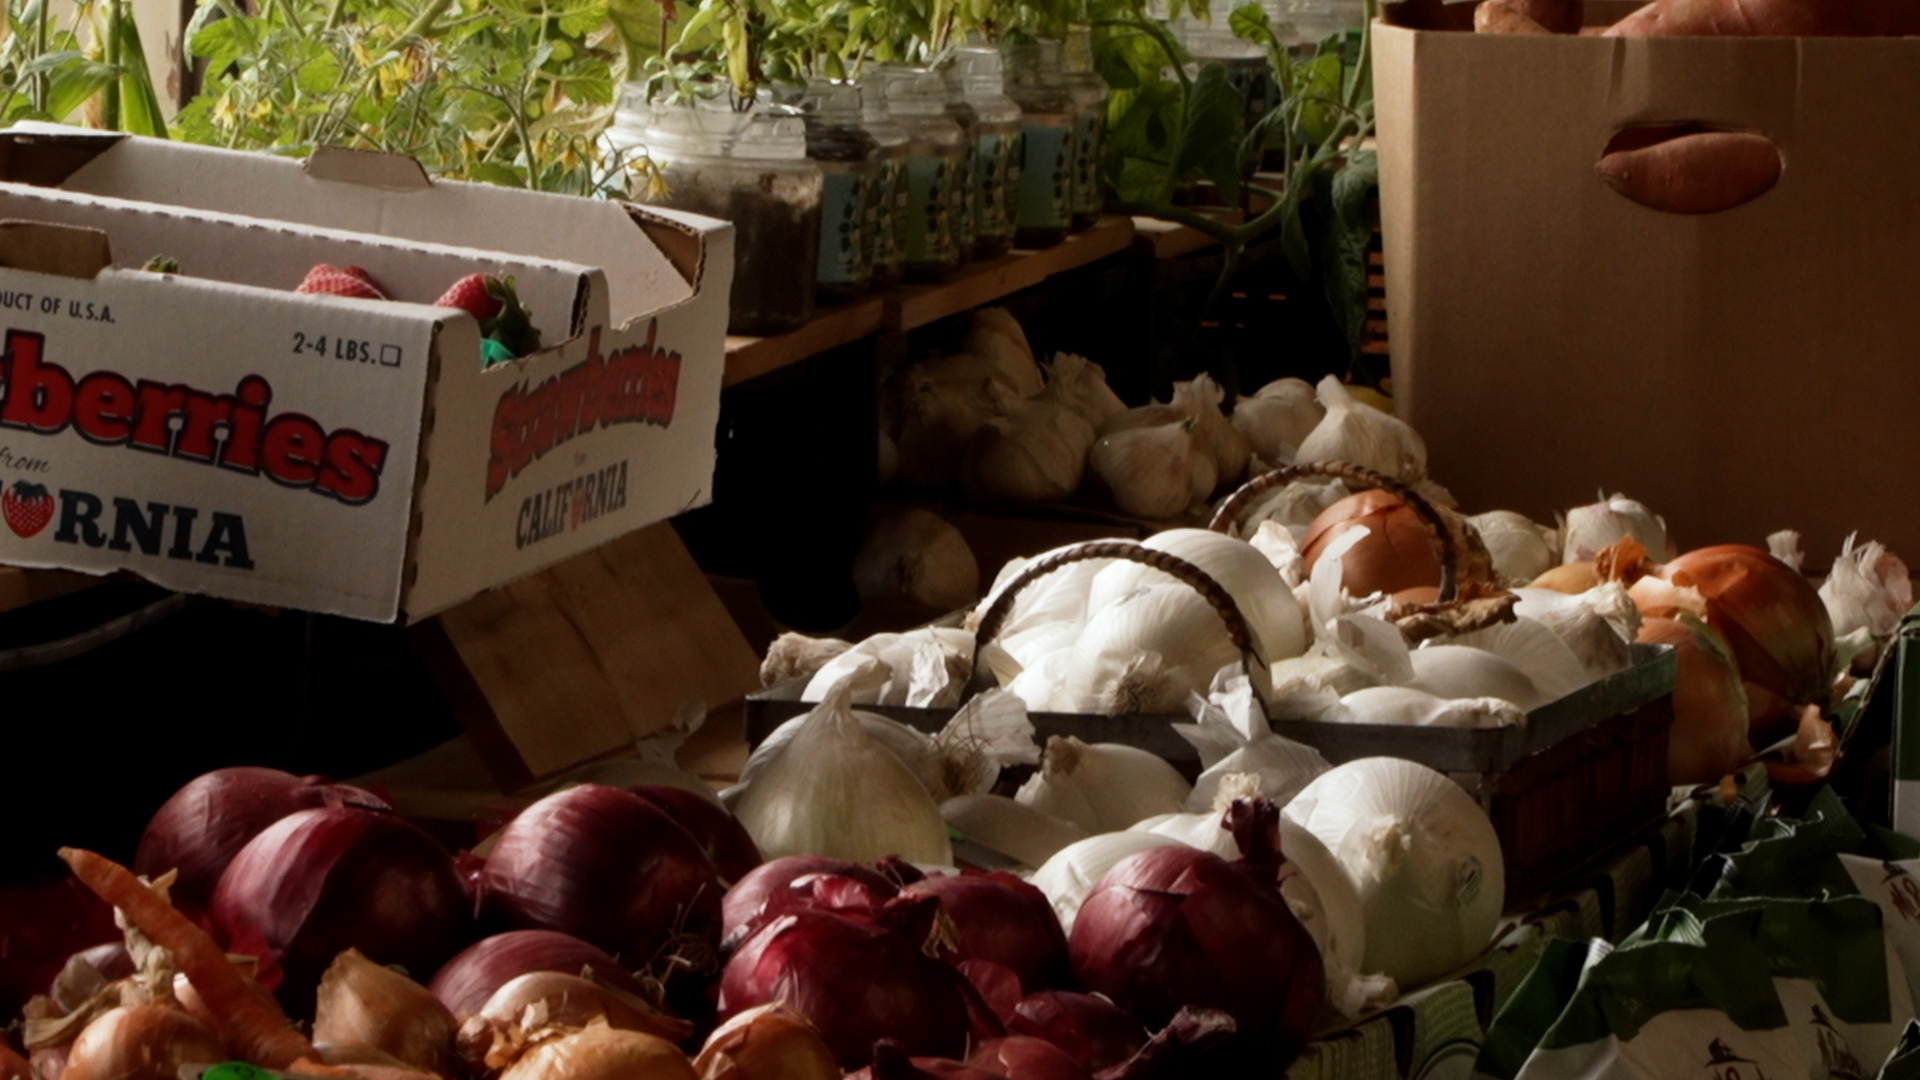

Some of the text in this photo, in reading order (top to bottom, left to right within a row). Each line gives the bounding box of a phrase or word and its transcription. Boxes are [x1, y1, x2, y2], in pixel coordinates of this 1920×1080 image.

[0, 290, 116, 324] UCT OF U.S.A.
[292, 332, 377, 366] 2-4 LBS.
[0, 328, 389, 506] berries
